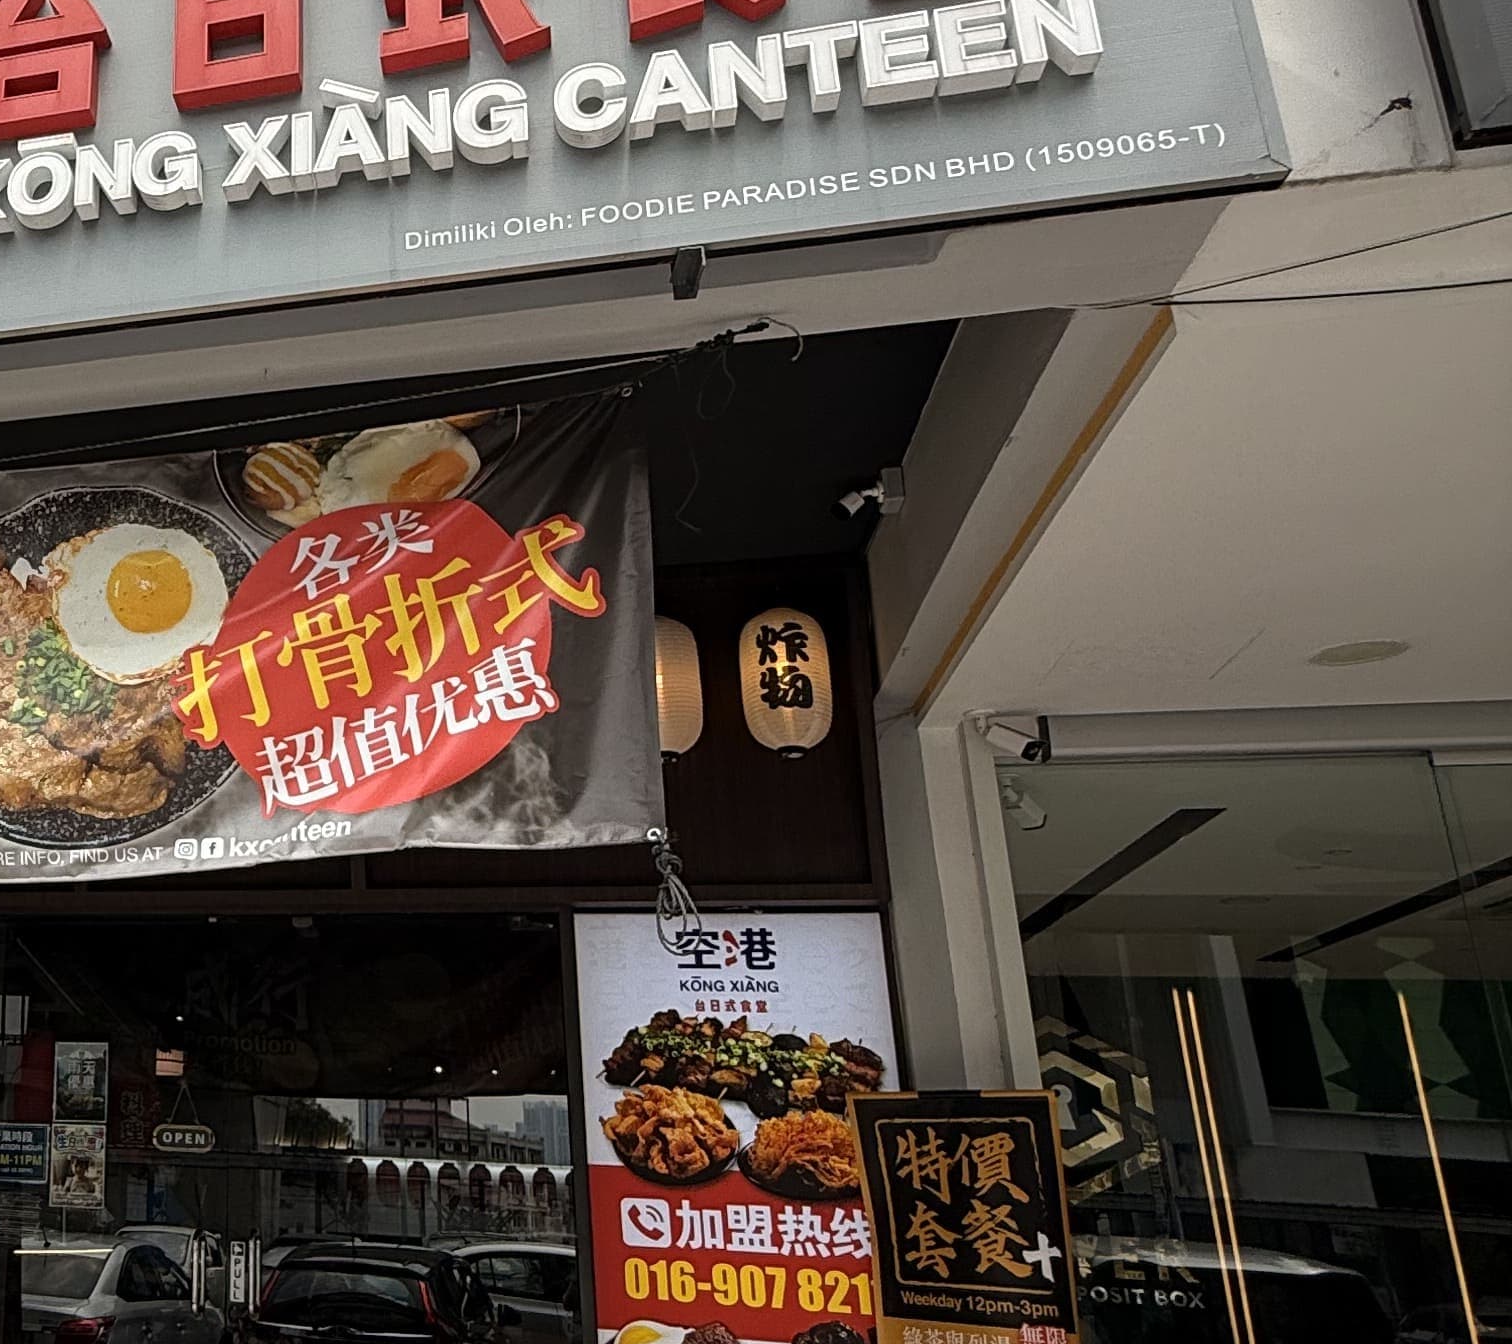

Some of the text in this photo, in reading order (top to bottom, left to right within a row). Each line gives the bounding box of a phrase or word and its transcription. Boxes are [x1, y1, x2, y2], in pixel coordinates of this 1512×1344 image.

[222, 77, 529, 202] XIÀNG
[404, 122, 1227, 251] Dimiliki Oleh: FOODIE PARADISE SDN BHD (1509065-T)
[291, 508, 435, 601] 各类
[179, 522, 600, 742] 打骨折式
[755, 622, 814, 710] 炸物
[255, 636, 554, 812] 超值优惠
[19, 850, 65, 867] INFO,
[68, 849, 110, 864] FIND
[114, 847, 138, 863] US
[141, 845, 164, 862] AT
[679, 975, 780, 993] KŌNG XIÀNG
[694, 998, 768, 1014] 台日式食堂
[162, 1131, 206, 1145] OPEN
[895, 1125, 1030, 1205] 特價
[904, 1198, 1035, 1279] 套餐
[233, 1258, 242, 1300] PULL
[623, 1257, 875, 1316] 016-907 821
[900, 1290, 1060, 1318] Weekday 12pm-3pm
[1153, 1288, 1207, 1310] BOX
